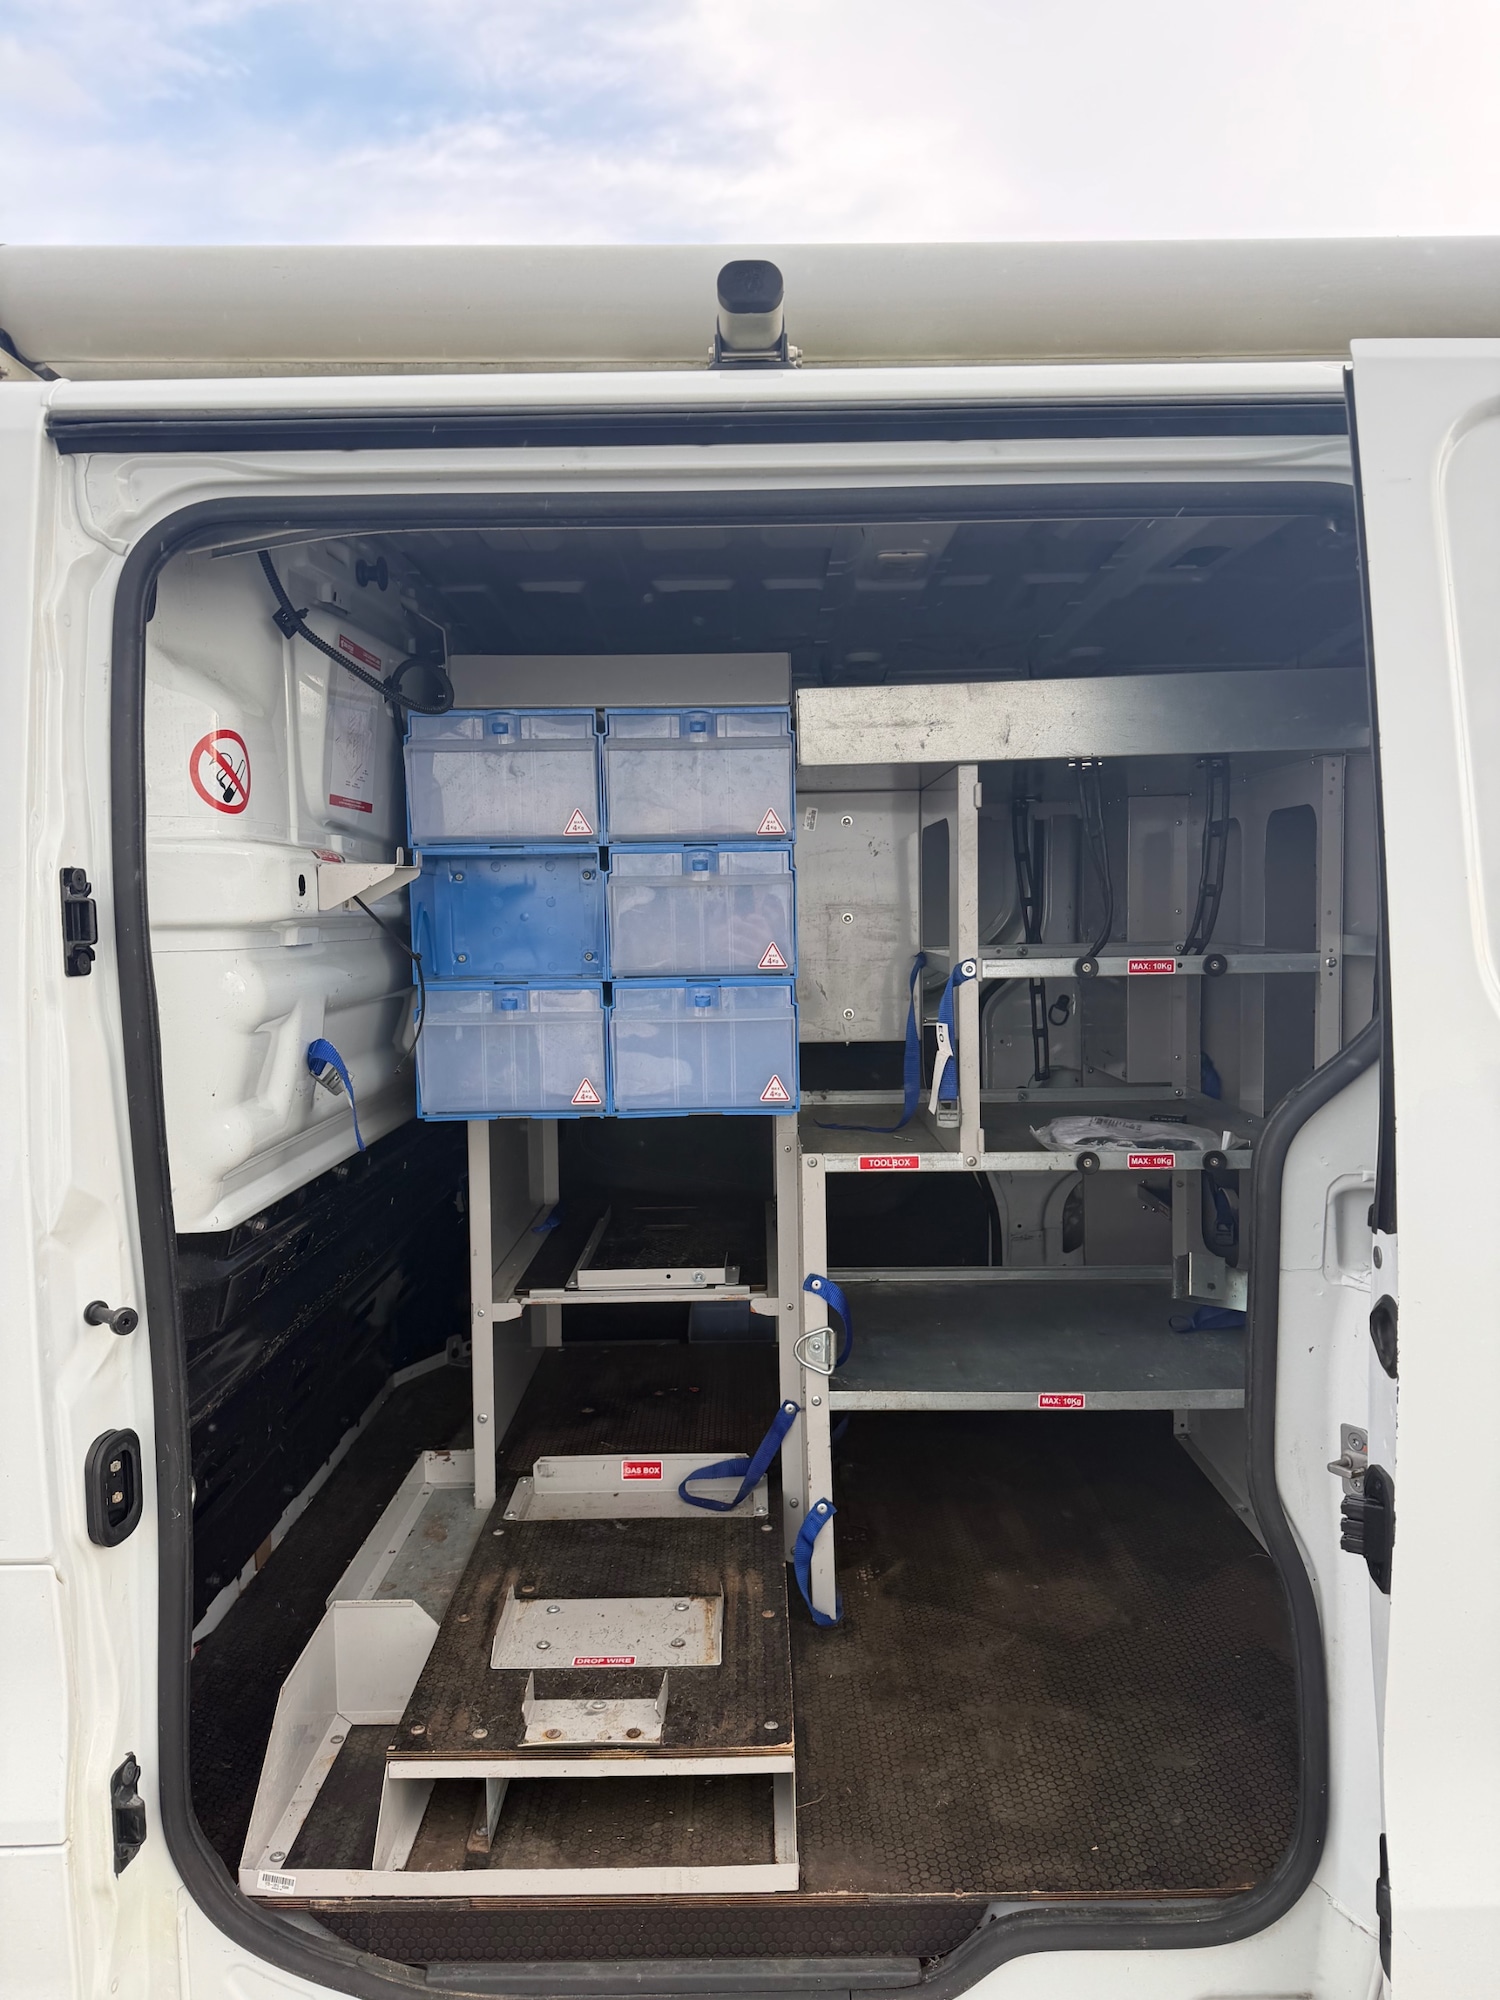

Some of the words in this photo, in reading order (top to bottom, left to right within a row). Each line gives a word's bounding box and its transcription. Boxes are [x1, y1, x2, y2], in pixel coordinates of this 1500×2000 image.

[1131, 962, 1151, 970] MAX:
[1153, 962, 1172, 971] 10Kg
[868, 1158, 911, 1167] TOOLBOX
[1131, 1157, 1151, 1165] MAX:
[1153, 1157, 1172, 1166] 10Kg
[1041, 1397, 1061, 1405] MAX:
[1063, 1397, 1082, 1406] 10Kg
[625, 1466, 642, 1474] GAS
[643, 1466, 660, 1474] BOX
